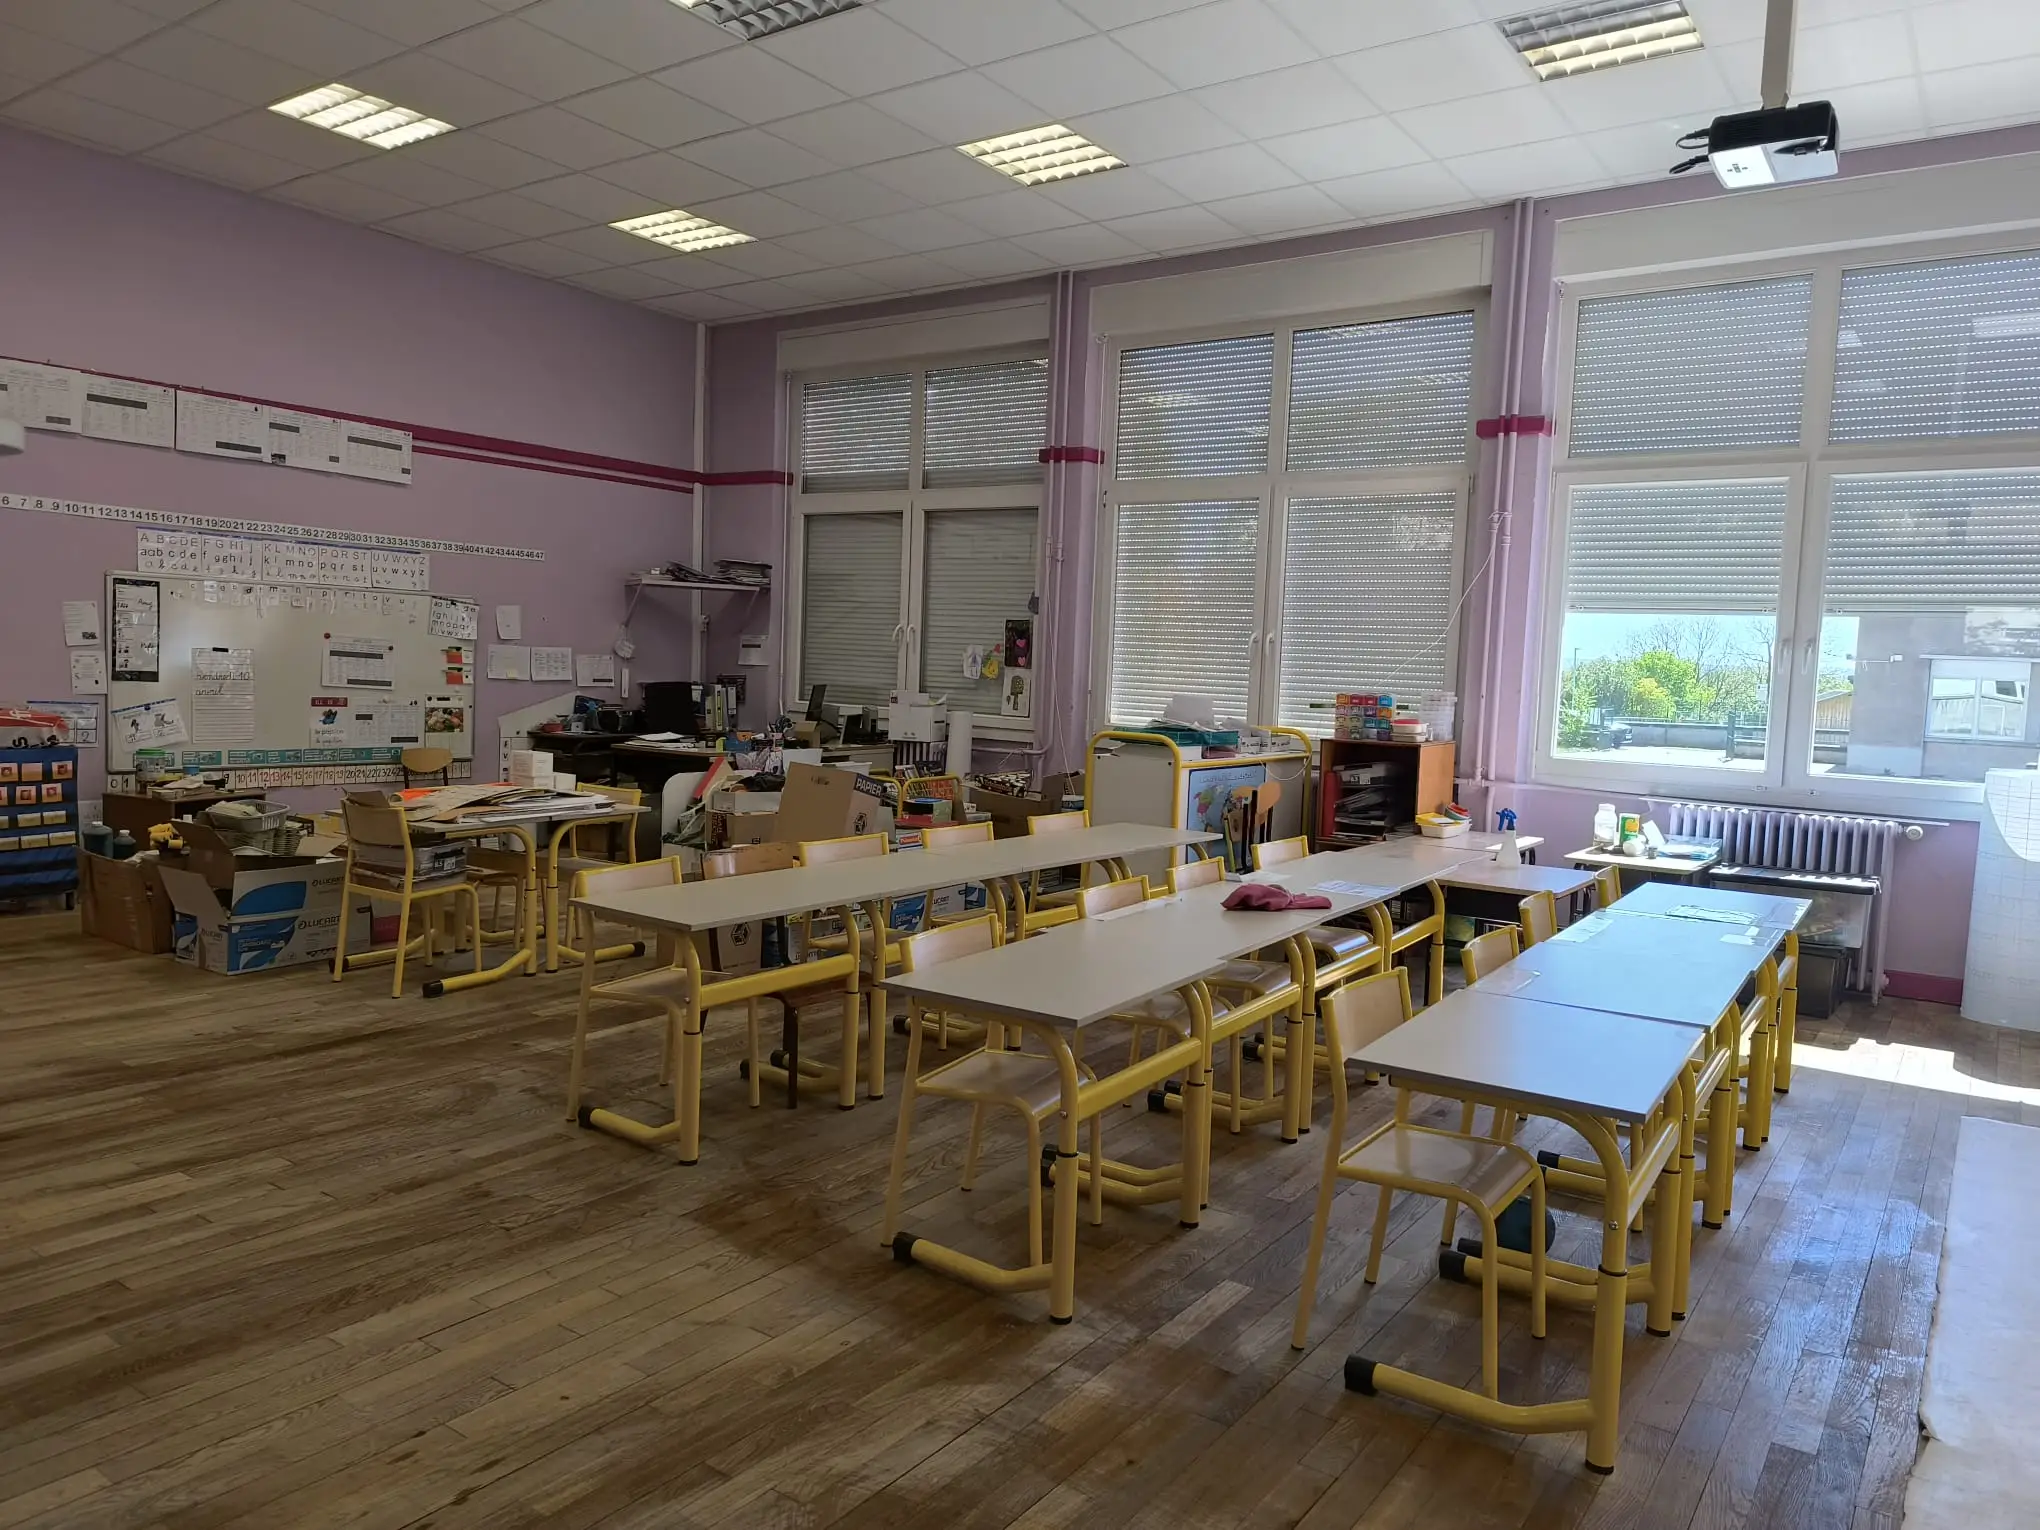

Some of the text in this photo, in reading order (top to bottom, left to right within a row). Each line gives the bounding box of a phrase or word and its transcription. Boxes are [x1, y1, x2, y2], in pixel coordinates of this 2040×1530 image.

[2, 496, 544, 559] 6 7 8 9 10 11 12 13 14 15 16 17 18 19 20 21 22 23 24 25 26 27 28 29 30 31 32 33 34 35 36 37 38 39 40 41 42 43 44 45 46 47
[140, 532, 149, 542] A
[156, 534, 164, 544] B
[180, 537, 188, 546] D
[190, 537, 198, 547] E
[204, 538, 210, 547] F
[215, 540, 224, 548] G
[230, 540, 238, 550] H
[264, 544, 272, 553] K
[275, 544, 280, 553] L
[298, 546, 306, 556] N
[320, 548, 328, 557] P
[331, 550, 339, 558] Q
[341, 550, 349, 559] R
[352, 551, 359, 560] S
[361, 551, 368, 560] T
[373, 552, 380, 562] U
[382, 553, 389, 562] V
[391, 554, 401, 562] W
[402, 555, 409, 563] X
[411, 556, 418, 564] Y
[419, 557, 426, 565] Z
[157, 548, 163, 557] b
[168, 550, 175, 558] c
[180, 550, 186, 559] d
[203, 550, 207, 559] f
[229, 553, 236, 563] h
[264, 555, 269, 564] k
[285, 559, 295, 567] m
[320, 562, 326, 570] p
[330, 563, 336, 571] q
[391, 567, 399, 575] w
[410, 569, 416, 578] y
[419, 568, 424, 576] z
[110, 778, 117, 788] 0
[237, 774, 245, 783] 10
[248, 772, 257, 782] 11
[259, 772, 269, 782] 12
[270, 772, 280, 782] 13
[281, 772, 291, 781] 14
[294, 770, 302, 780] 15
[304, 770, 313, 779] 16
[315, 770, 323, 779] 17
[324, 770, 334, 779] 18
[336, 769, 344, 779] 19
[346, 768, 356, 778] 20
[356, 768, 366, 778] 21
[367, 768, 377, 777] 22
[377, 767, 387, 777] 23
[387, 767, 396, 777] 24
[856, 778, 882, 796] PAPIER
[933, 895, 950, 904] UCART
[307, 916, 341, 927] LUCART
